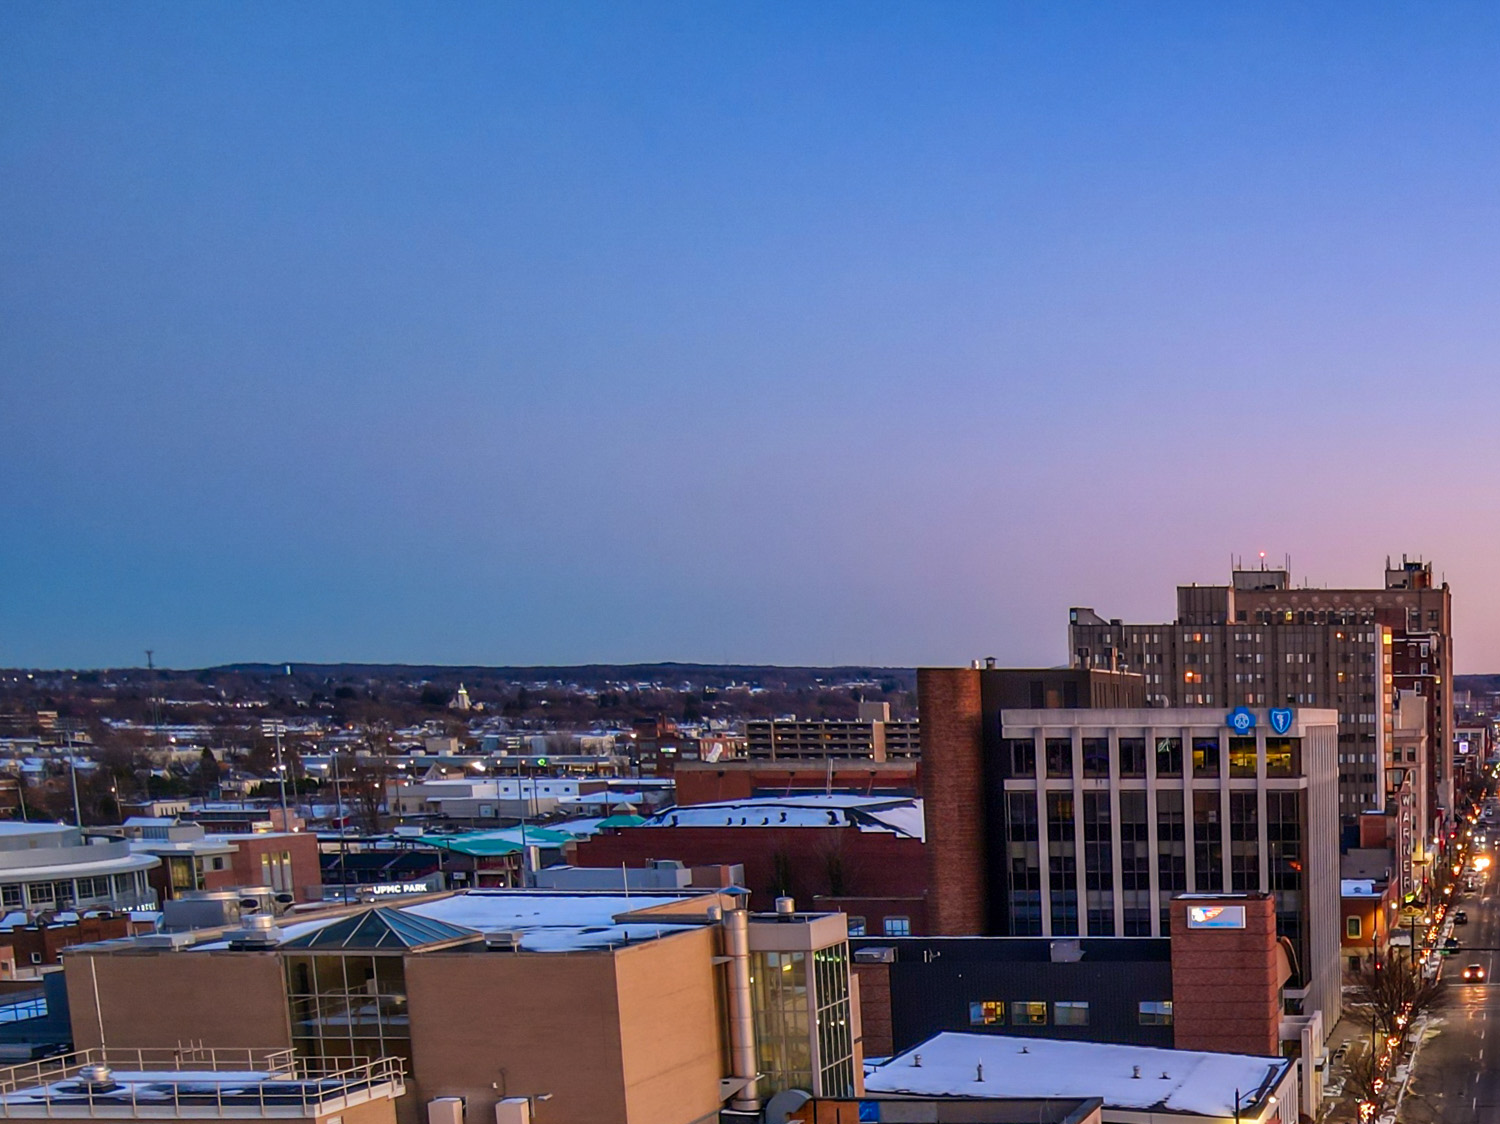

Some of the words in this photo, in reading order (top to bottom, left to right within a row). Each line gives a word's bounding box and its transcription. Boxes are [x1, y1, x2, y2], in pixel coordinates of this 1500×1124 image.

[1402, 795, 1410, 888] WARNER
[373, 885, 401, 894] UPMC
[403, 883, 427, 893] PARK
